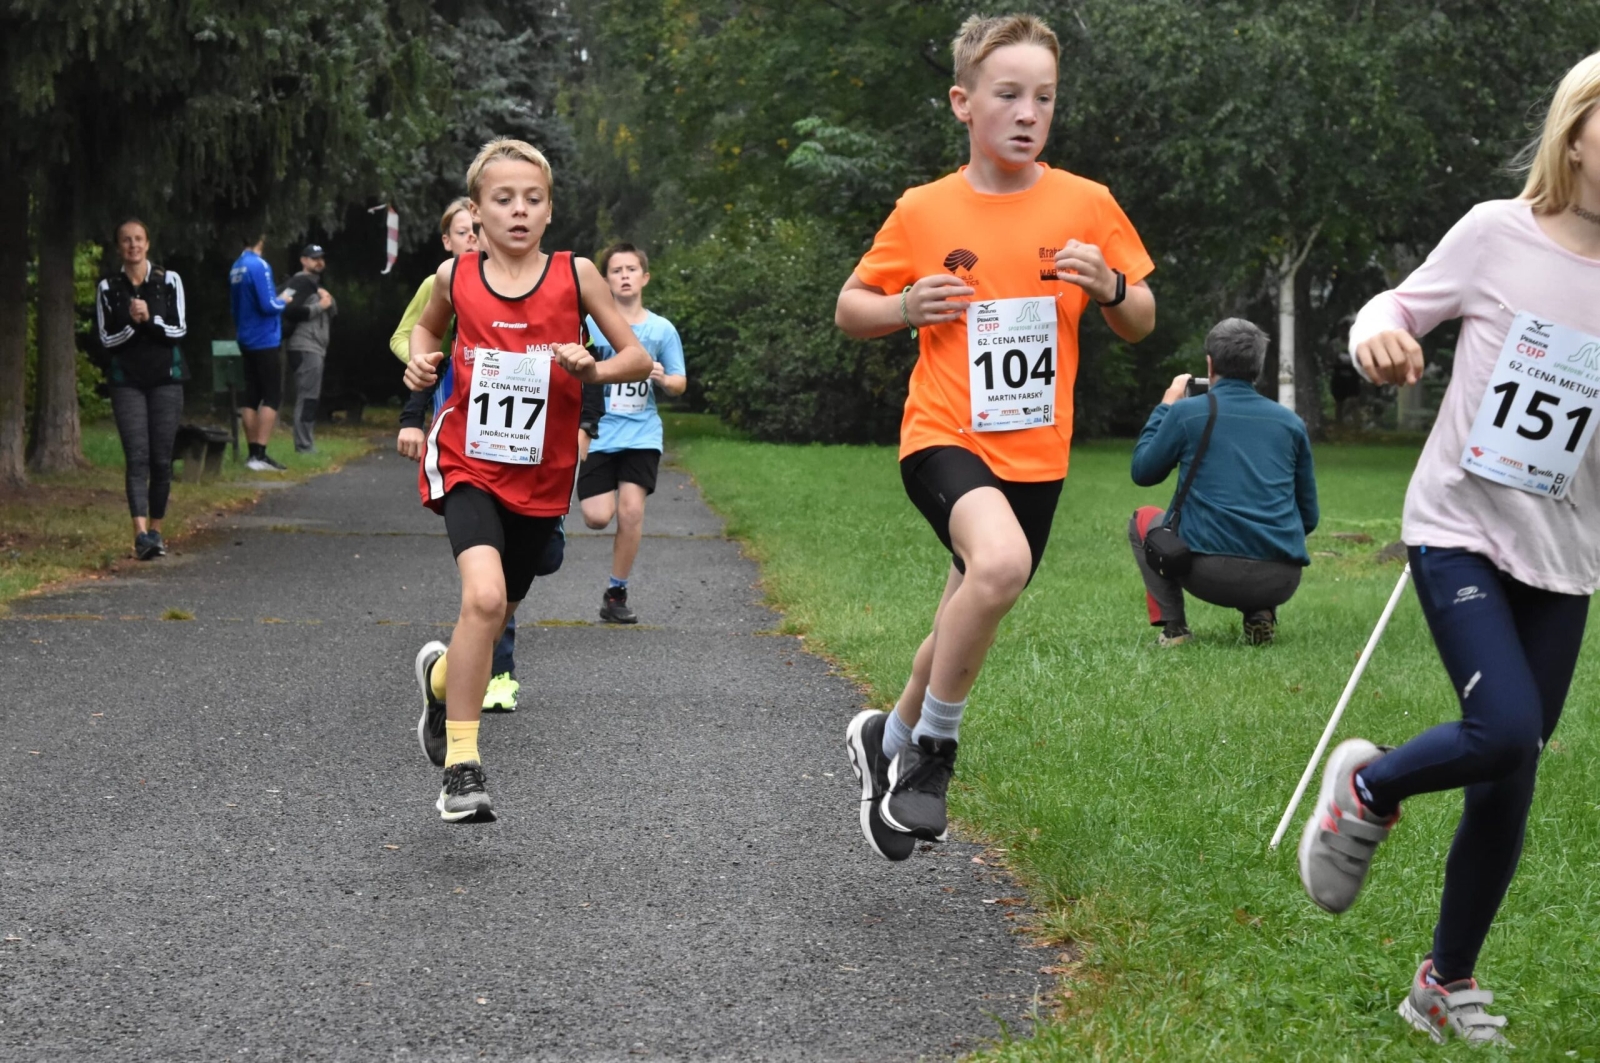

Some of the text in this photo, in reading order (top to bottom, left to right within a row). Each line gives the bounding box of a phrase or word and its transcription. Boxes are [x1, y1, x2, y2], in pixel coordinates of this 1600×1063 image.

[977, 323, 1000, 332] CUP
[978, 337, 990, 346] 62.
[992, 335, 1016, 345] CENA
[1018, 334, 1049, 344] METUJE
[1516, 343, 1546, 359] CUP
[974, 347, 1055, 390] 104
[1509, 360, 1600, 398] 62. CENA METUJE
[513, 385, 540, 394] METUJE
[616, 381, 649, 397] 150
[1018, 391, 1043, 400] FARSKÝ
[474, 392, 545, 430] 117
[1493, 381, 1593, 453] 151
[480, 429, 530, 440] JINDŘICH KUBÍK
